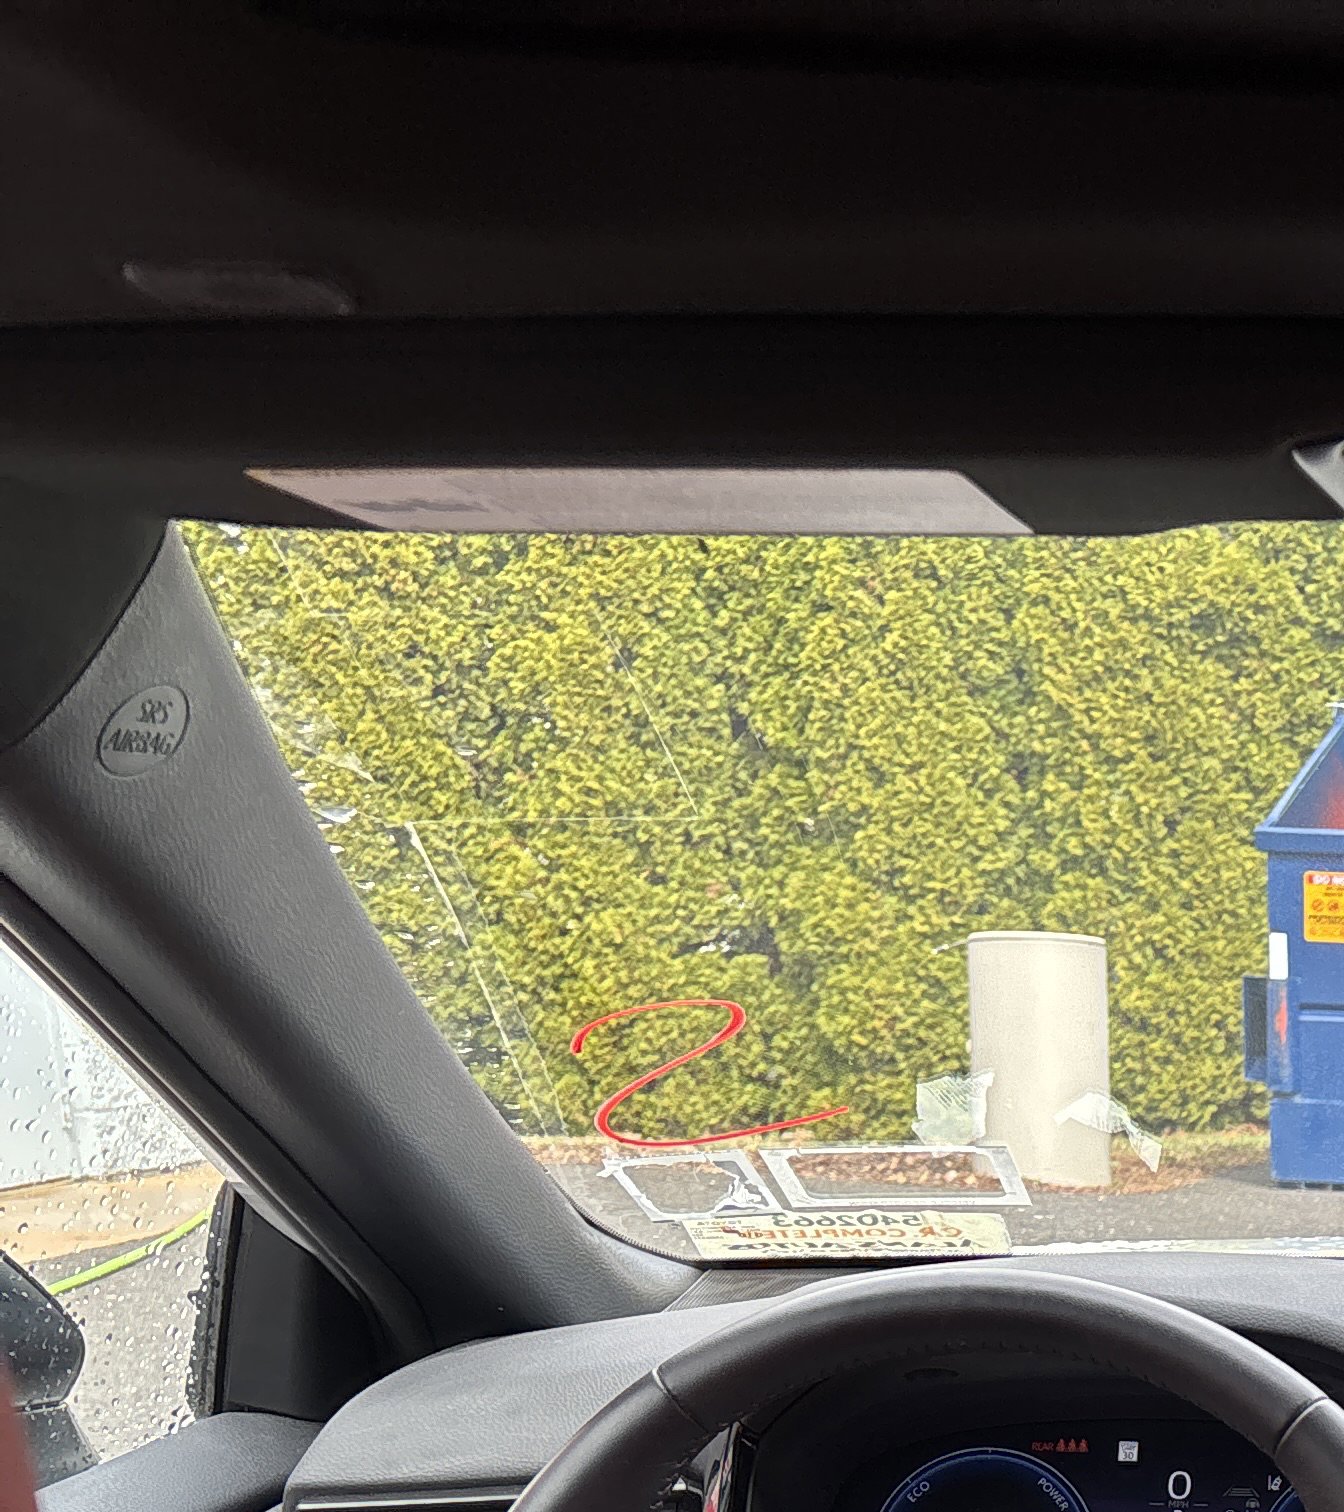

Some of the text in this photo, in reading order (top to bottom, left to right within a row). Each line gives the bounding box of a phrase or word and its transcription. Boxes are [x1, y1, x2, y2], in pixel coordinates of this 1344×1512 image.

[1122, 1451, 1135, 1461] 30
[906, 1480, 931, 1503] ECO
[1037, 1477, 1069, 1511] POWER
[1167, 1470, 1192, 1500] 0
